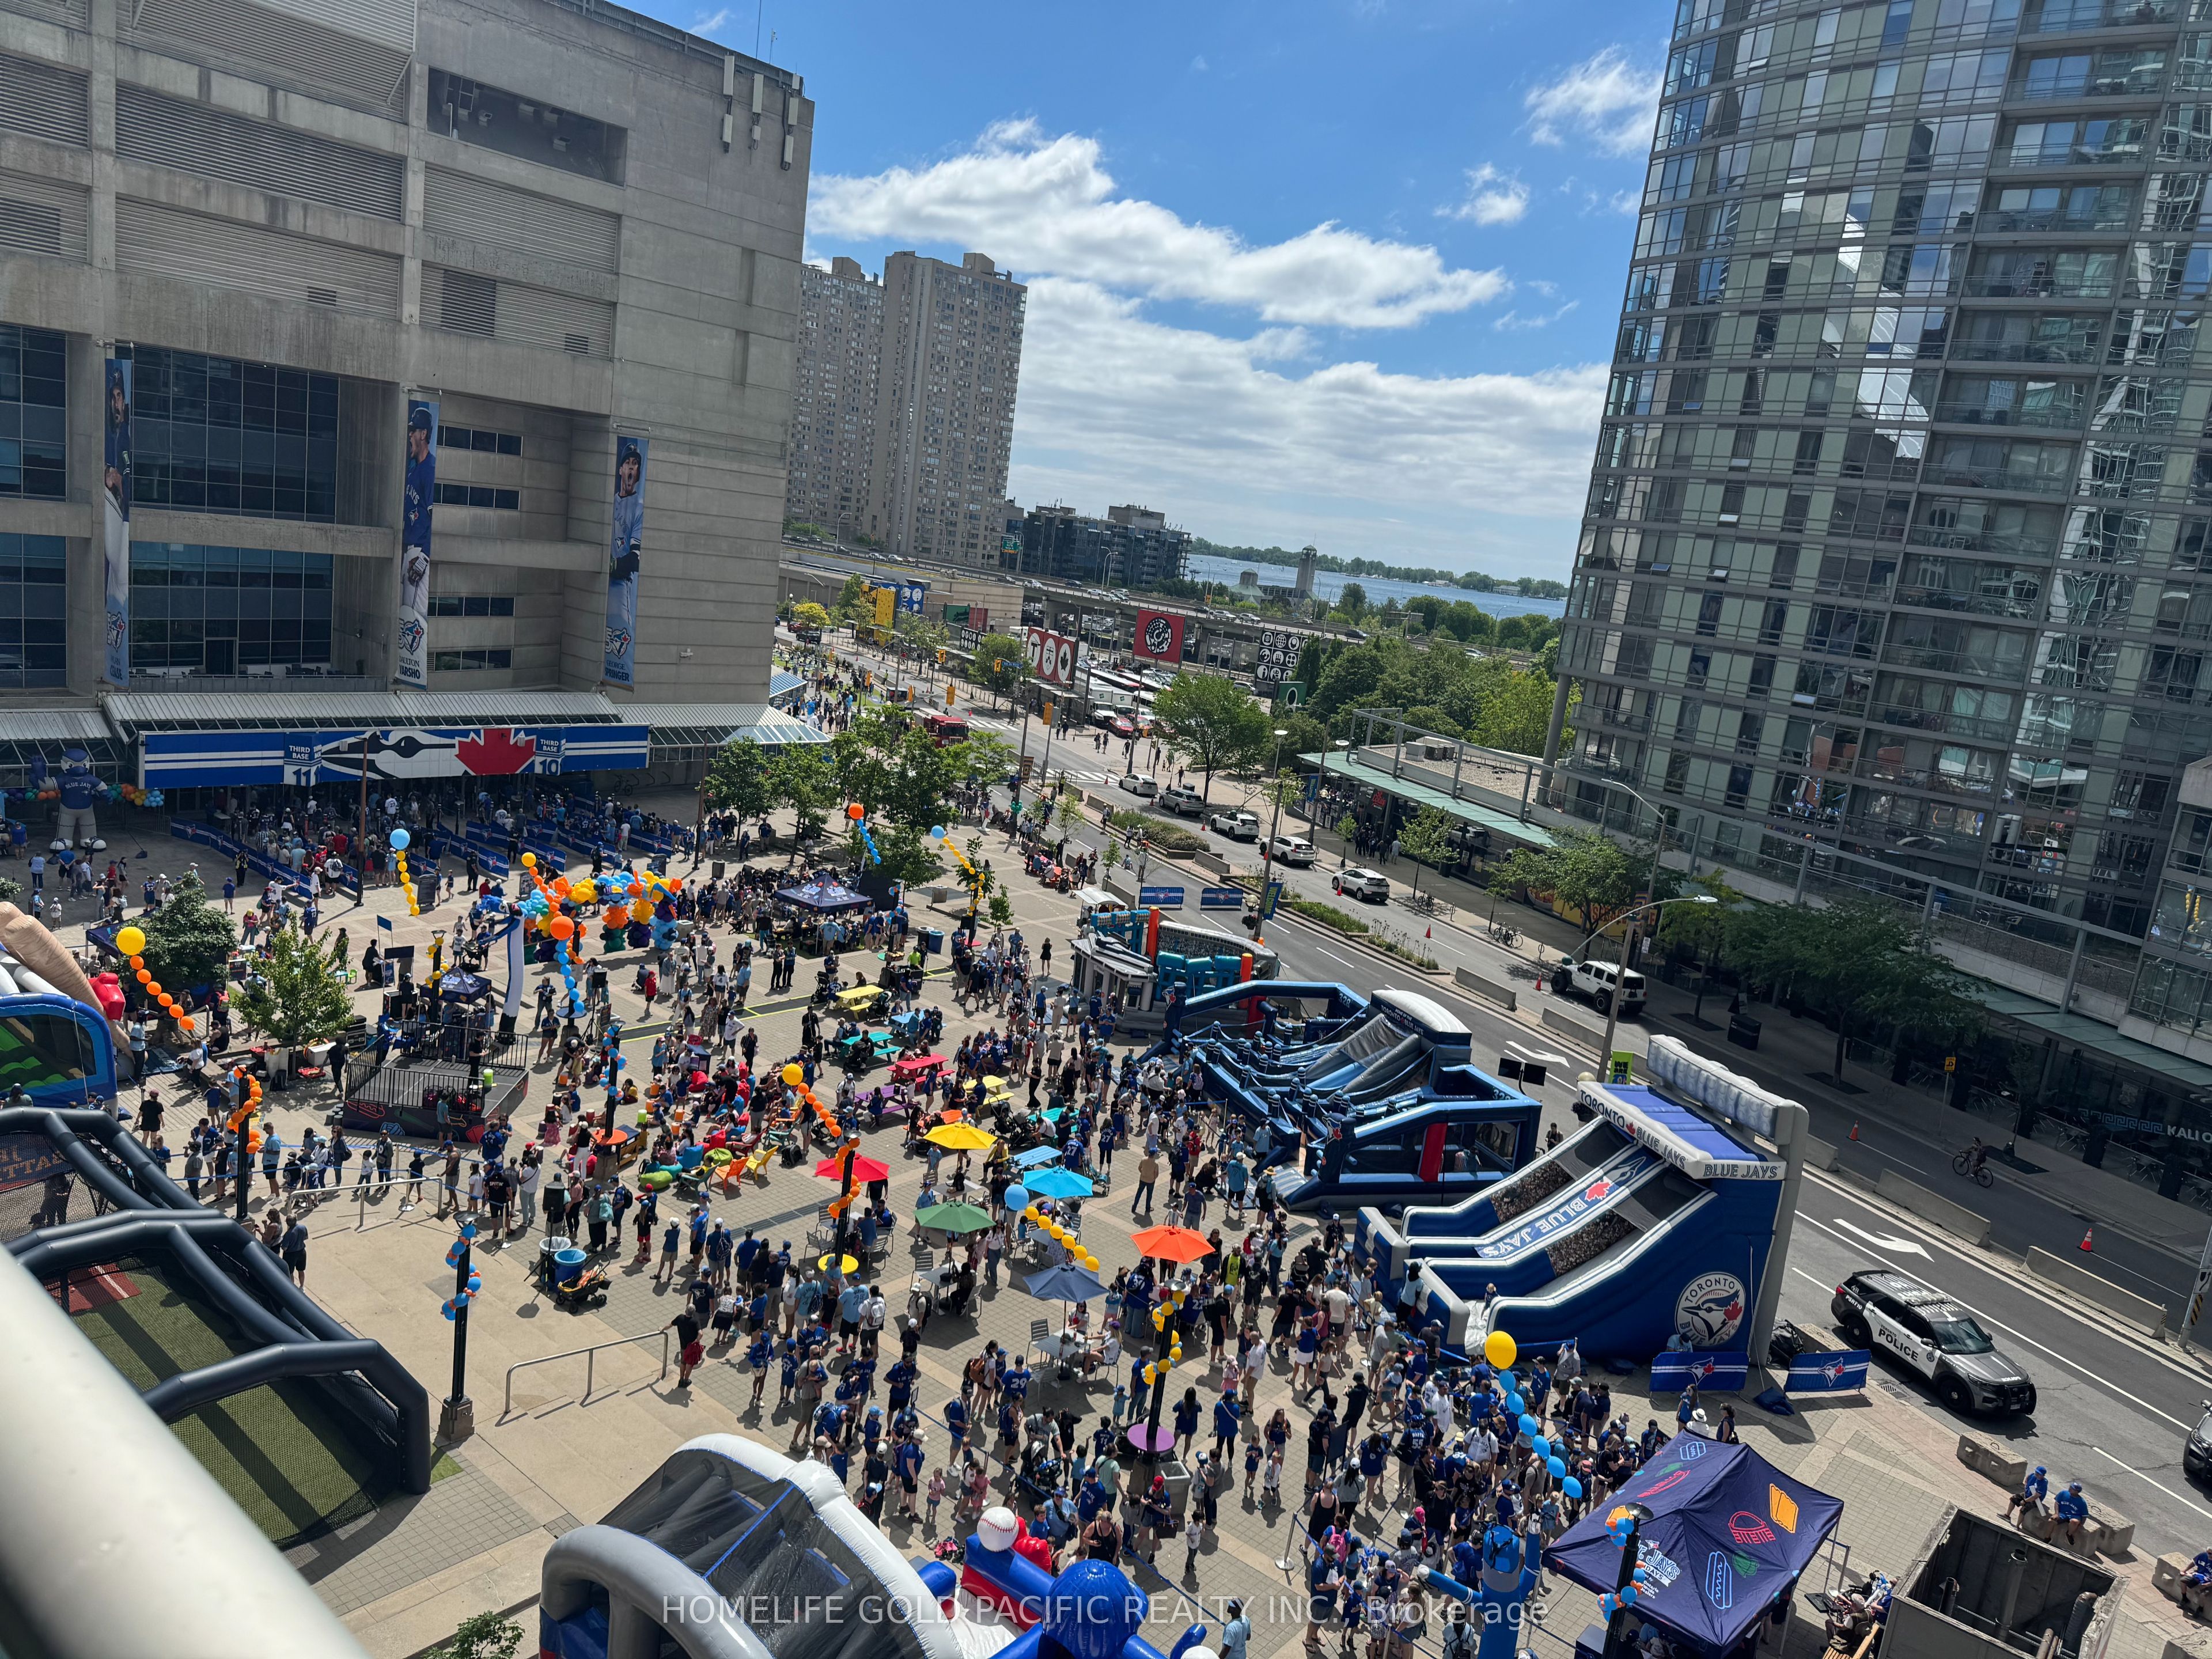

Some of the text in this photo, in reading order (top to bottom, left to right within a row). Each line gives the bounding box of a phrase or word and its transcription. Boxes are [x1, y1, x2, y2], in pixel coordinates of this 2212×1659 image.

[399, 665, 421, 679] VARSHO
[607, 660, 625, 671] GEORGE
[605, 668, 630, 682] SPRINGER
[539, 758, 559, 776] 10
[292, 767, 311, 787] 11
[1381, 1005, 1400, 1021] TORONTO
[1581, 1089, 1686, 1169] TORONTO BLUE JAYS
[1067, 1146, 1077, 1156] 27
[1703, 1164, 1778, 1179] BLUE JAYS
[1483, 1197, 1588, 1257] BLUE JAYS
[1685, 1277, 1735, 1303] TORONTO
[1845, 1294, 1863, 1310] PSRT10
[1881, 1325, 1897, 1338] TORONTO
[1878, 1328, 1919, 1362] POLICE
[1011, 1378, 1027, 1388] 29
[1646, 1549, 1680, 1581] JAYS
